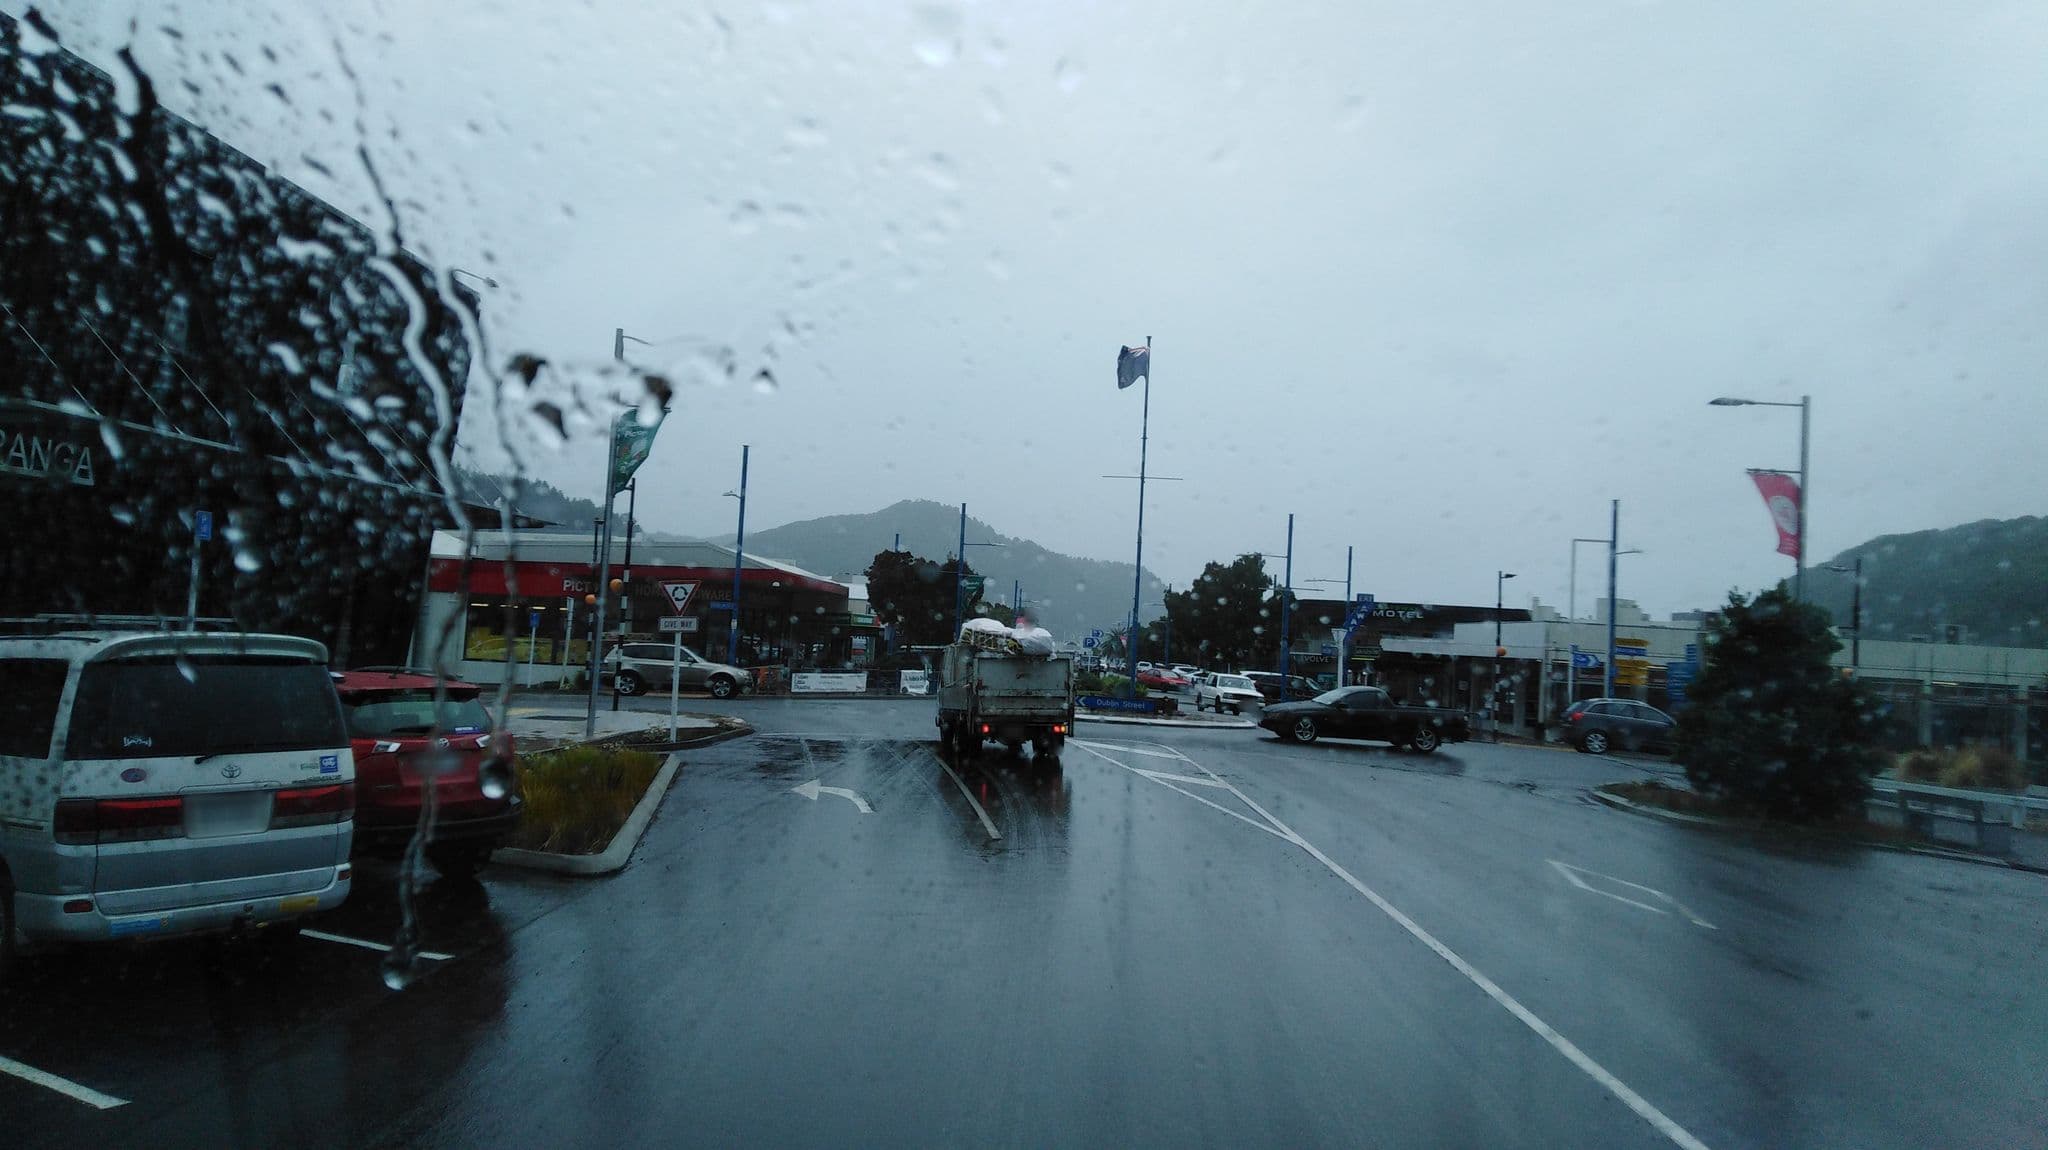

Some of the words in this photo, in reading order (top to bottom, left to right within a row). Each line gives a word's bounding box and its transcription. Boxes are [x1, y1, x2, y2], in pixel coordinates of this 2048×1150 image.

[1372, 610, 1424, 619] MOTEL
[1096, 698, 1120, 707] Dublin
[1122, 700, 1145, 709] Street
